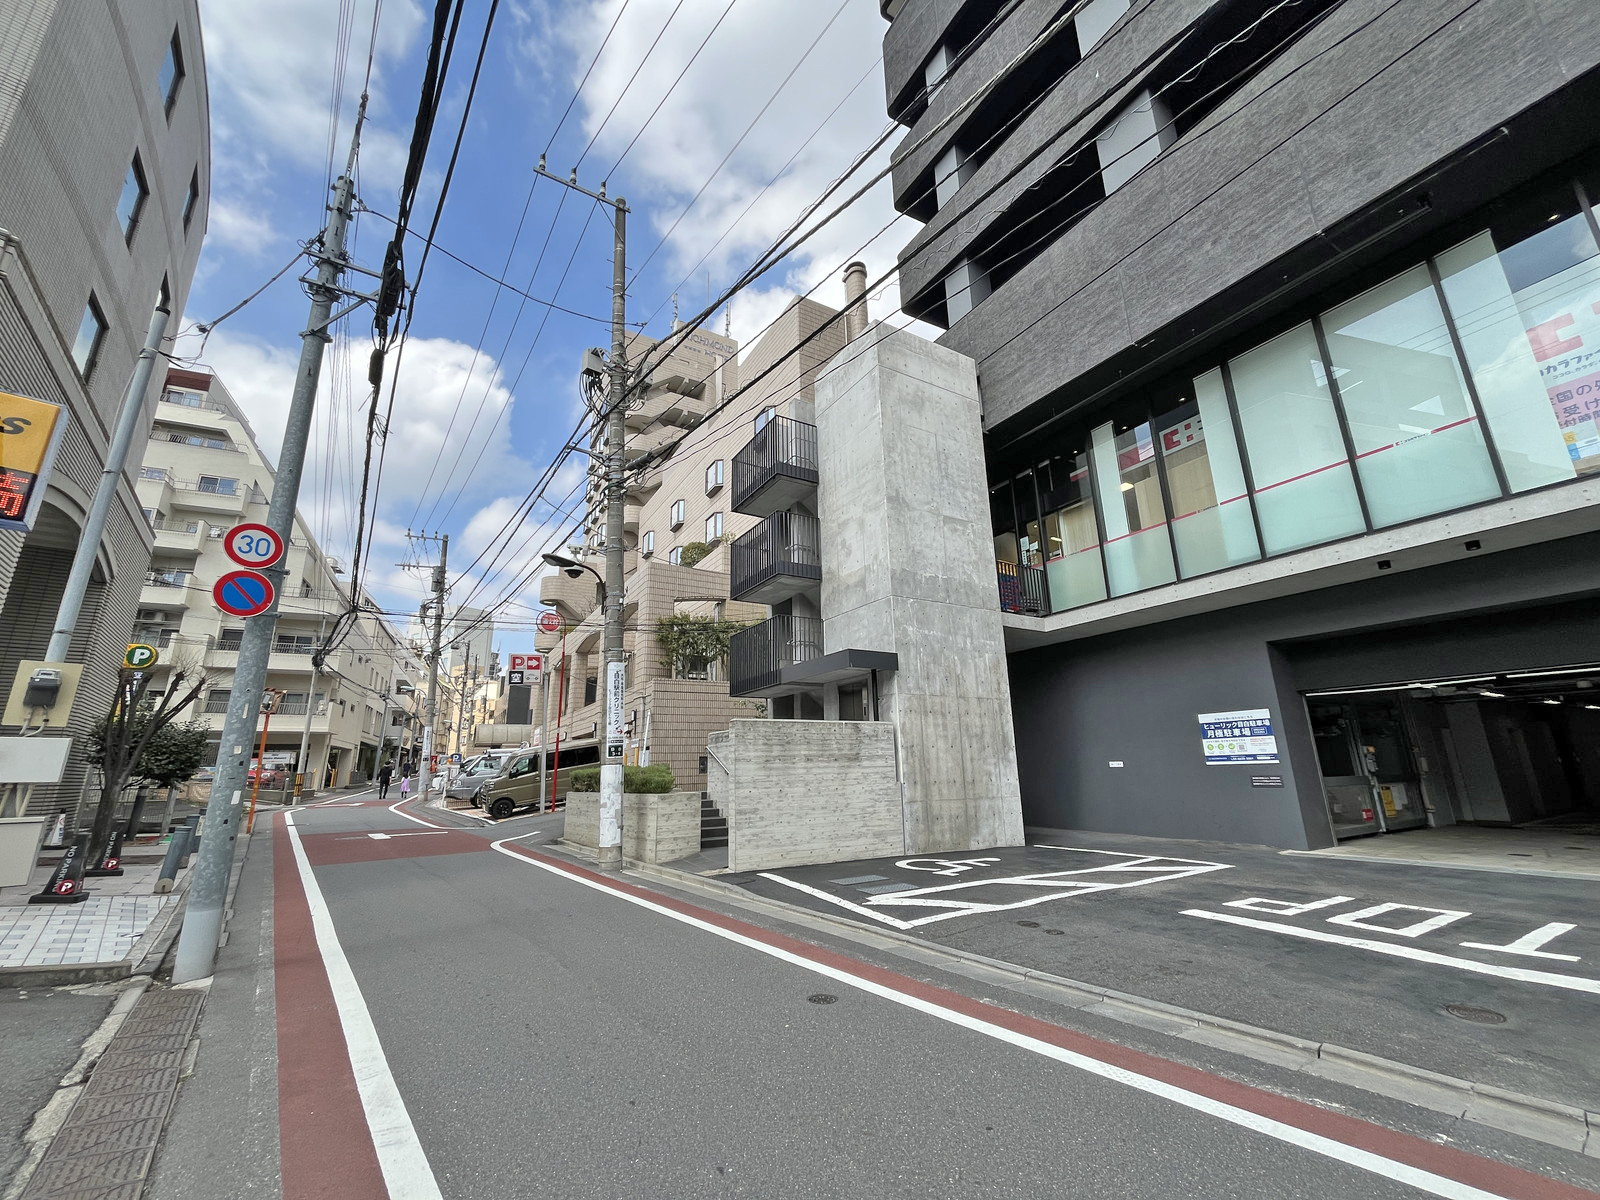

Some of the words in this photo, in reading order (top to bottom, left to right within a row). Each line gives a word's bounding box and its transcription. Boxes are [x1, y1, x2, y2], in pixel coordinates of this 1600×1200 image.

[238, 534, 271, 557] 30
[132, 648, 151, 665] P
[512, 656, 525, 670] P
[1207, 728, 1251, 738] 月極駐車場
[68, 845, 78, 857] NO
[51, 858, 72, 892] PARKIN
